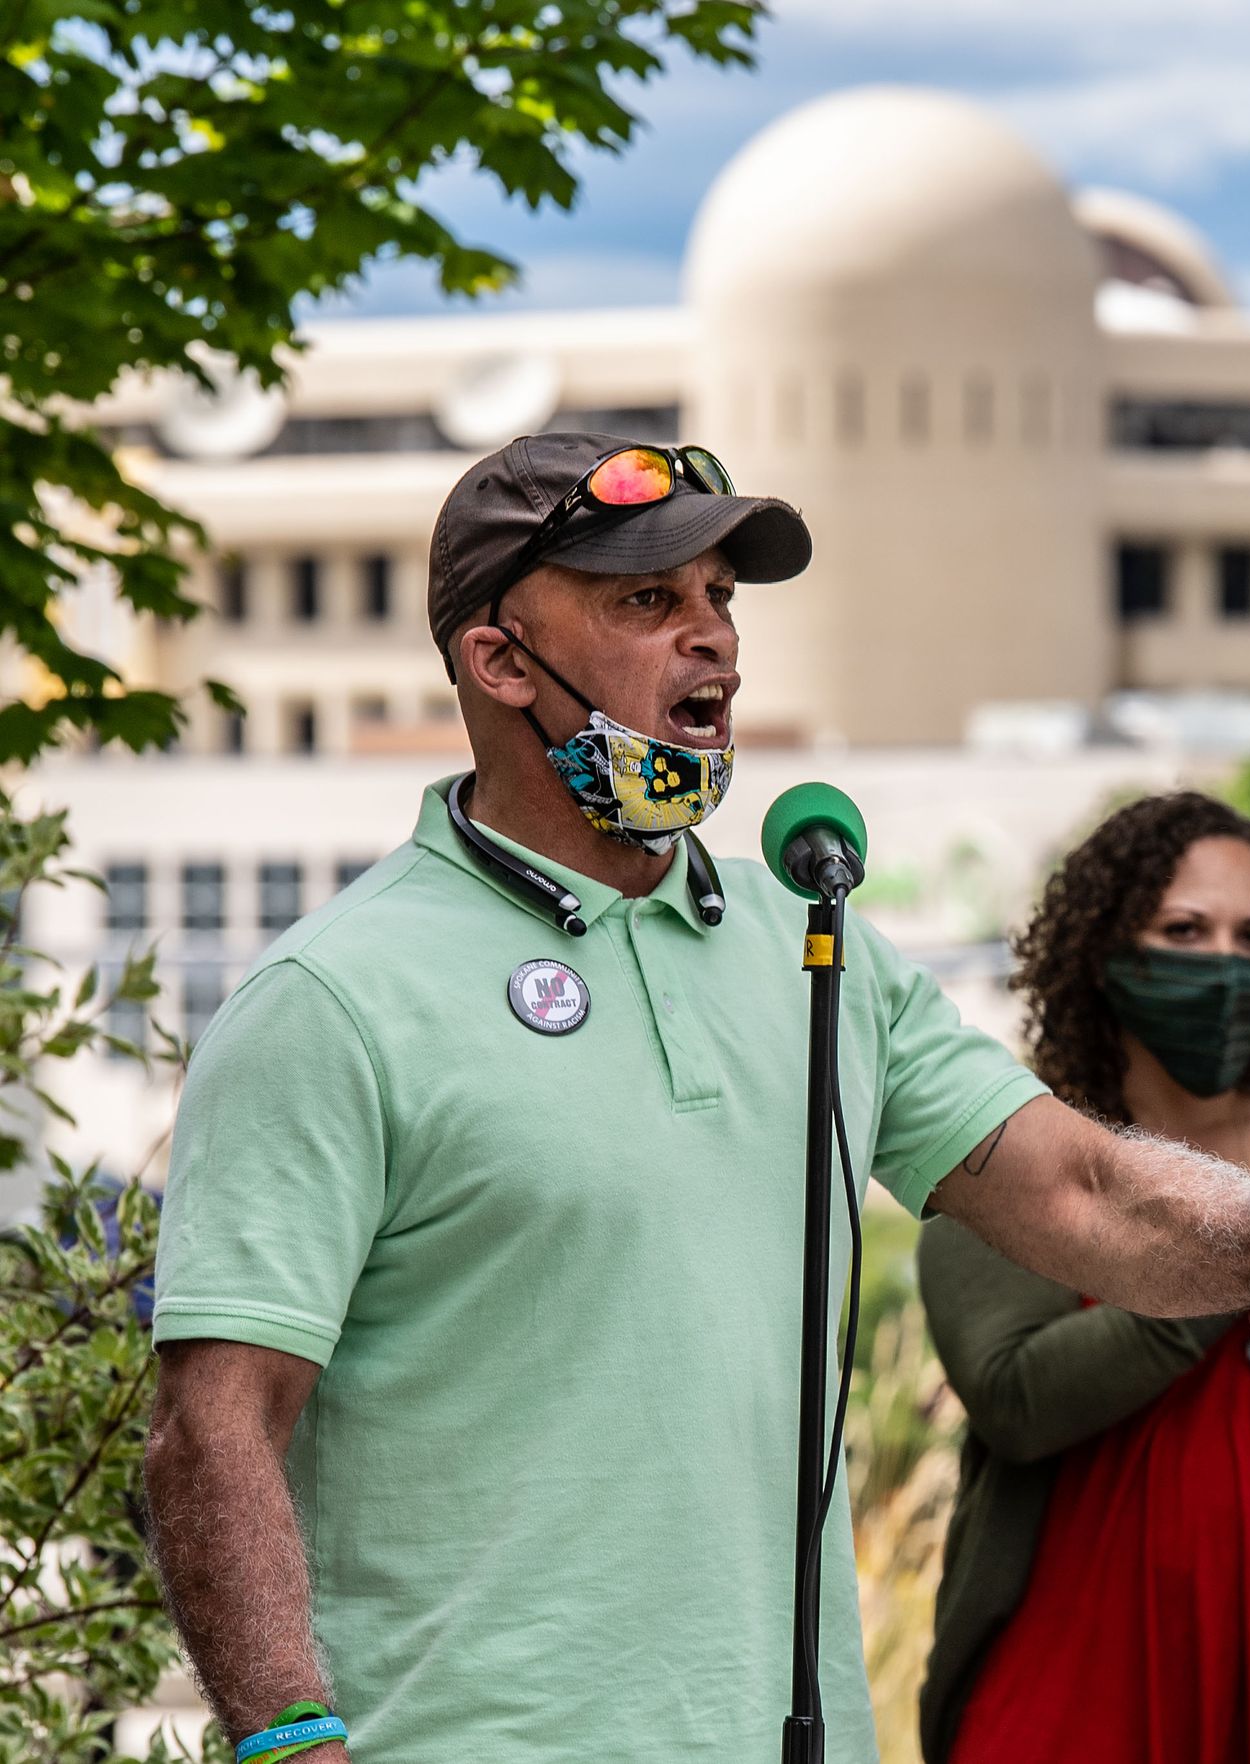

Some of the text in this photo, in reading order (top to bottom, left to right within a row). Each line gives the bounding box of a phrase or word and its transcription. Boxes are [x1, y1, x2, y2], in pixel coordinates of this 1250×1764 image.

[514, 960, 584, 989] SPOKANE COMMUNITY
[534, 976, 565, 998] NO
[530, 998, 577, 1010] CONTRACT
[526, 1009, 586, 1029] AGAINST RACISM
[275, 1720, 338, 1741] RECOVERY
